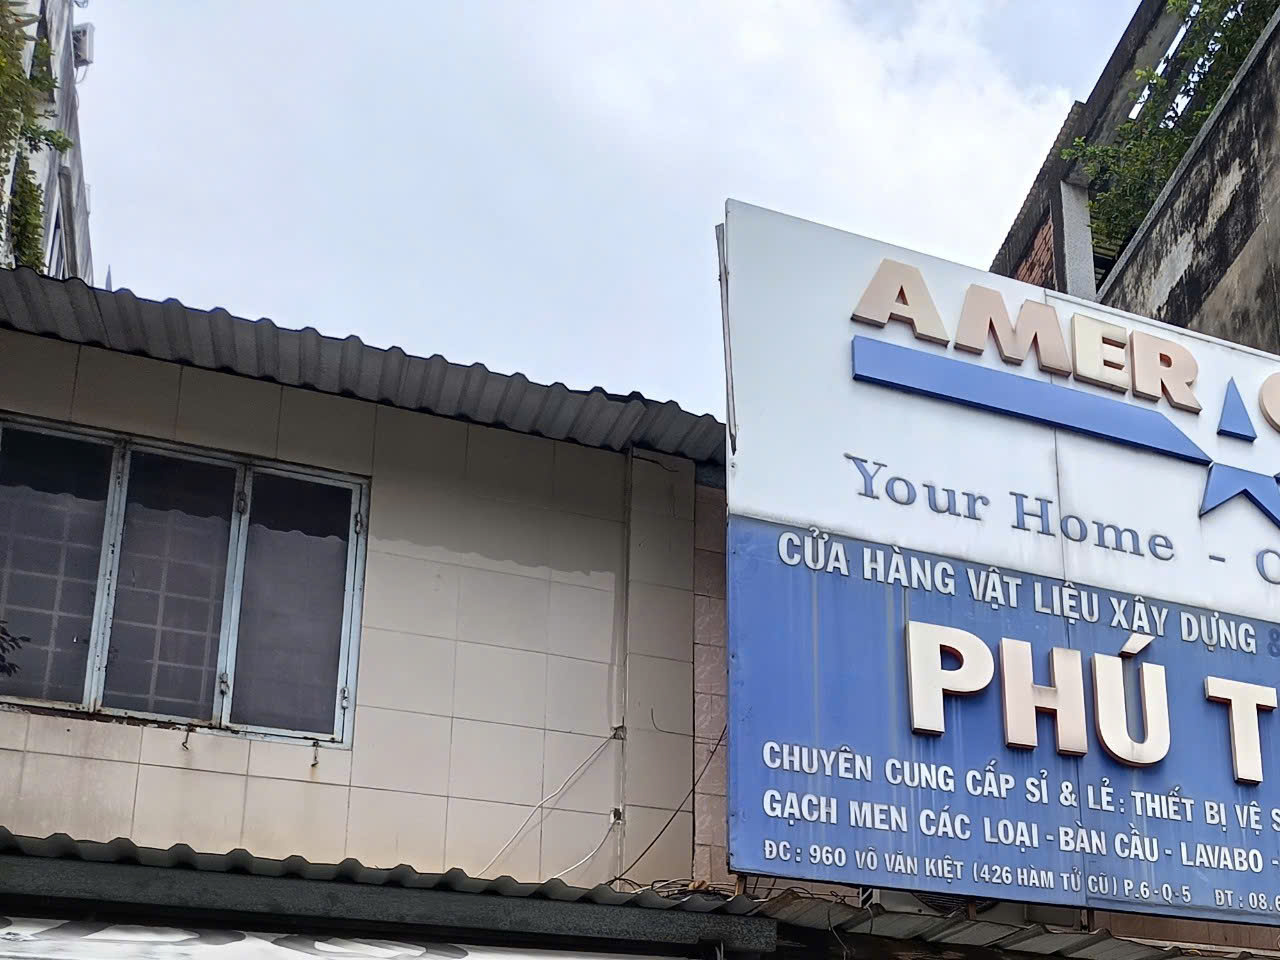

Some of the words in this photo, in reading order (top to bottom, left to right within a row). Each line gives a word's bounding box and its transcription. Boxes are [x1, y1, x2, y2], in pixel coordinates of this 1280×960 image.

[843, 453, 990, 521] Your
[1009, 491, 1176, 562] Home
[777, 527, 848, 577] CỬA
[862, 546, 956, 596] HÀNG
[967, 567, 1022, 612] VẬT
[1034, 580, 1100, 627] LIỆU
[1109, 594, 1168, 636] XÂY
[1180, 611, 1257, 656] DỰNG
[906, 620, 1172, 768] PHÚ
[762, 741, 872, 781] CHUYÊN
[885, 758, 955, 792] CUNG
[966, 759, 1015, 798] CẤP
[1025, 769, 1048, 805] SỈ
[1059, 781, 1078, 807] &
[1131, 785, 1194, 822] THIẾT
[1204, 805, 1227, 835] BỊ
[1235, 801, 1263, 836] VỆ
[762, 790, 838, 827] GẠCH
[850, 805, 907, 833] MEN
[919, 808, 971, 840] CÁC
[984, 818, 1039, 852] LOẠI
[1058, 821, 1107, 856] BÀN
[1114, 823, 1159, 862] CẦU
[1180, 841, 1263, 873] LAVABO
[809, 844, 847, 867] 960
[855, 845, 878, 870] VÕ
[884, 848, 918, 875] VĂN
[925, 853, 963, 882] KIỆT
[972, 862, 1013, 886] (426
[1017, 863, 1054, 889] HÀM
[1059, 866, 1083, 892] TỬ
